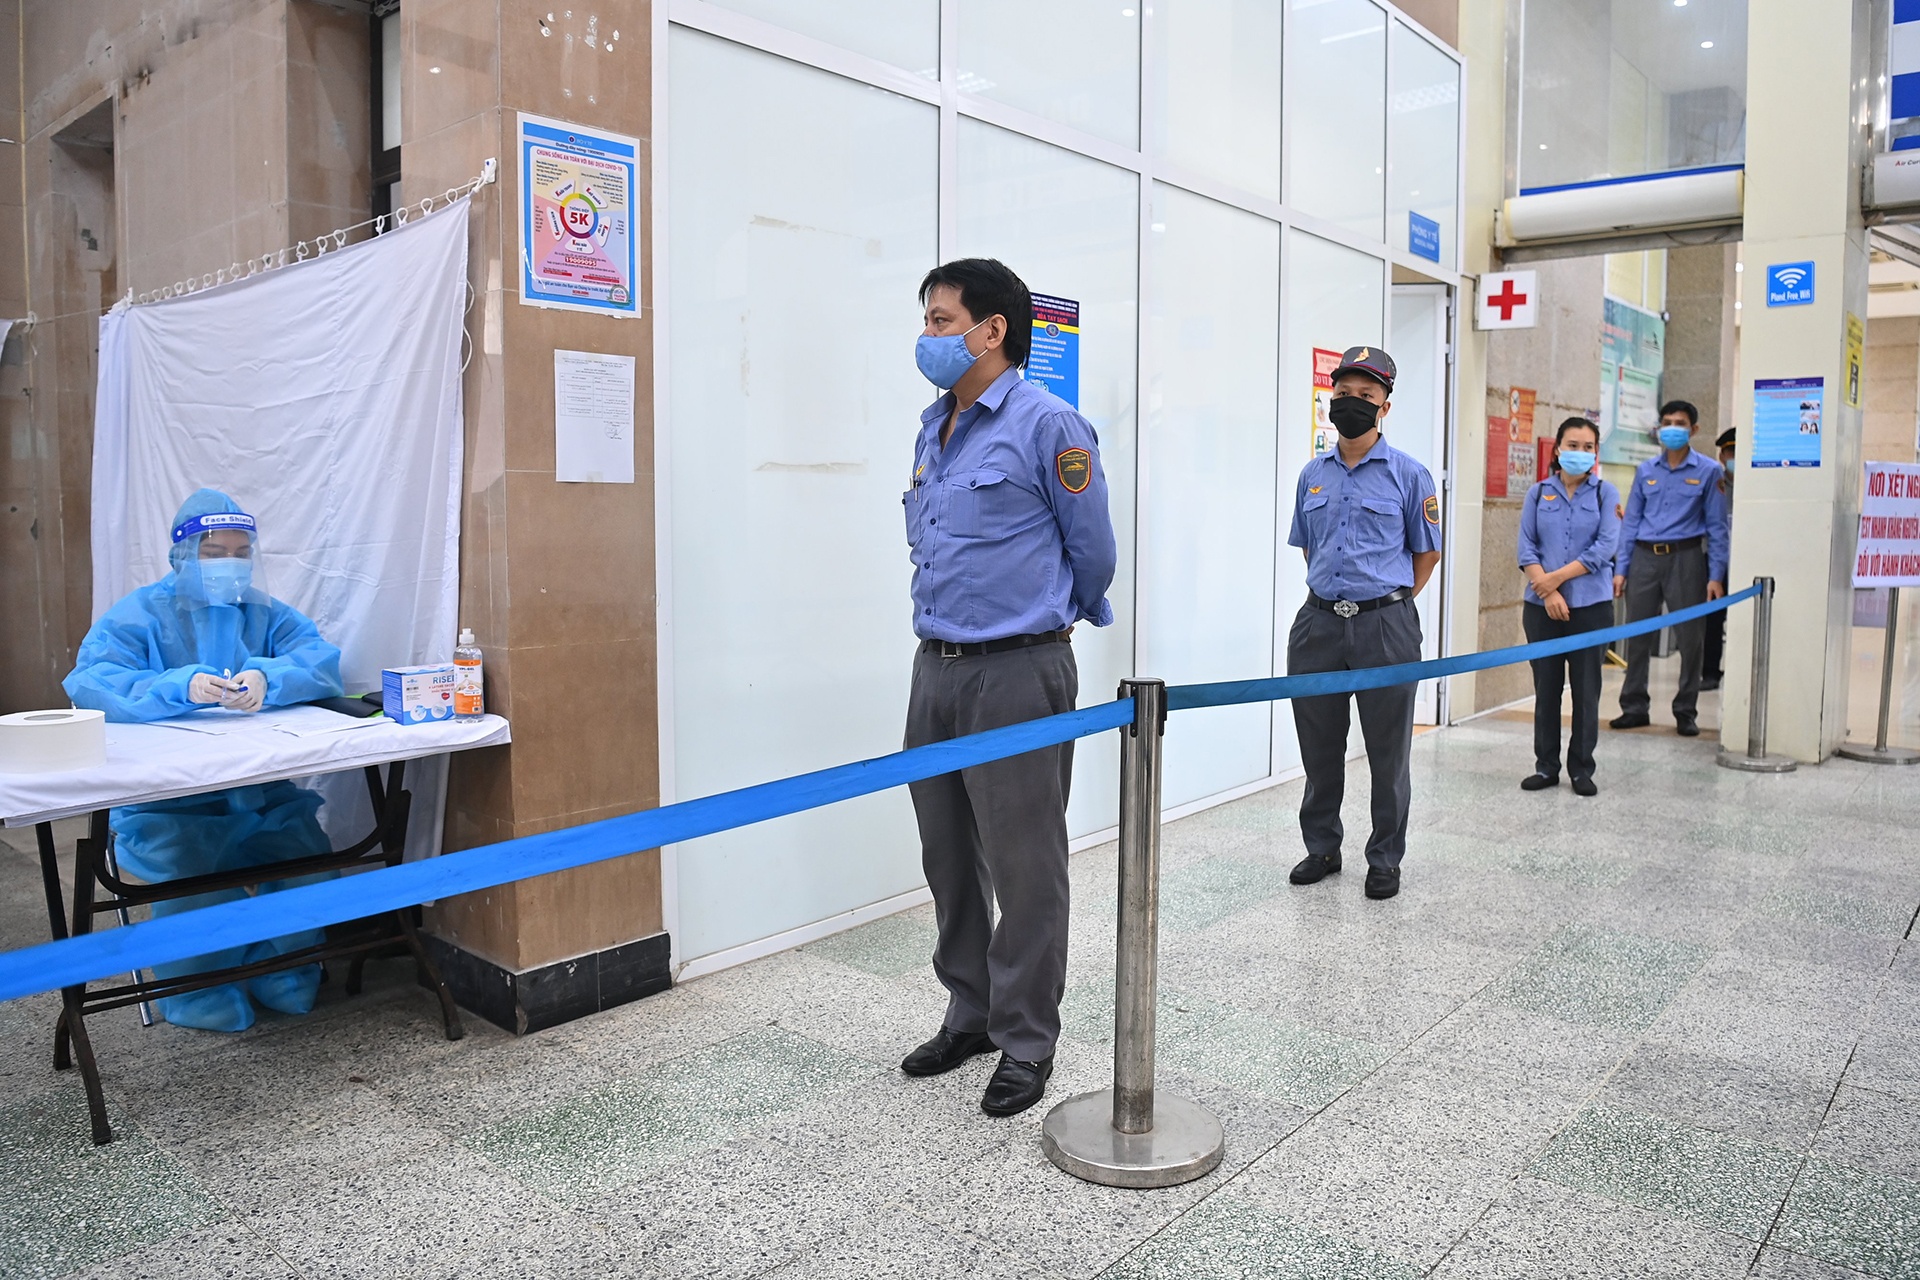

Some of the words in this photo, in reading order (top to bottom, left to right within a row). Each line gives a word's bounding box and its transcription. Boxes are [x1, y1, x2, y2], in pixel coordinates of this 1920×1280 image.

[536, 149, 552, 158] CHUNG
[552, 150, 563, 160] SỐNG
[570, 154, 580, 164] TOÀN
[596, 160, 604, 168] DỊCH
[604, 162, 622, 172] COVID-19
[570, 212, 589, 226] 5K
[1412, 224, 1427, 238] PHÒNG
[1868, 470, 1886, 497] NƠI
[1888, 468, 1905, 498] XÉT
[1906, 474, 1920, 498] NG
[228, 516, 252, 524] Shield
[1887, 512, 1902, 540] KHÁNG
[1857, 546, 1870, 577] ĐỐI
[1881, 549, 1900, 576] HÀNH
